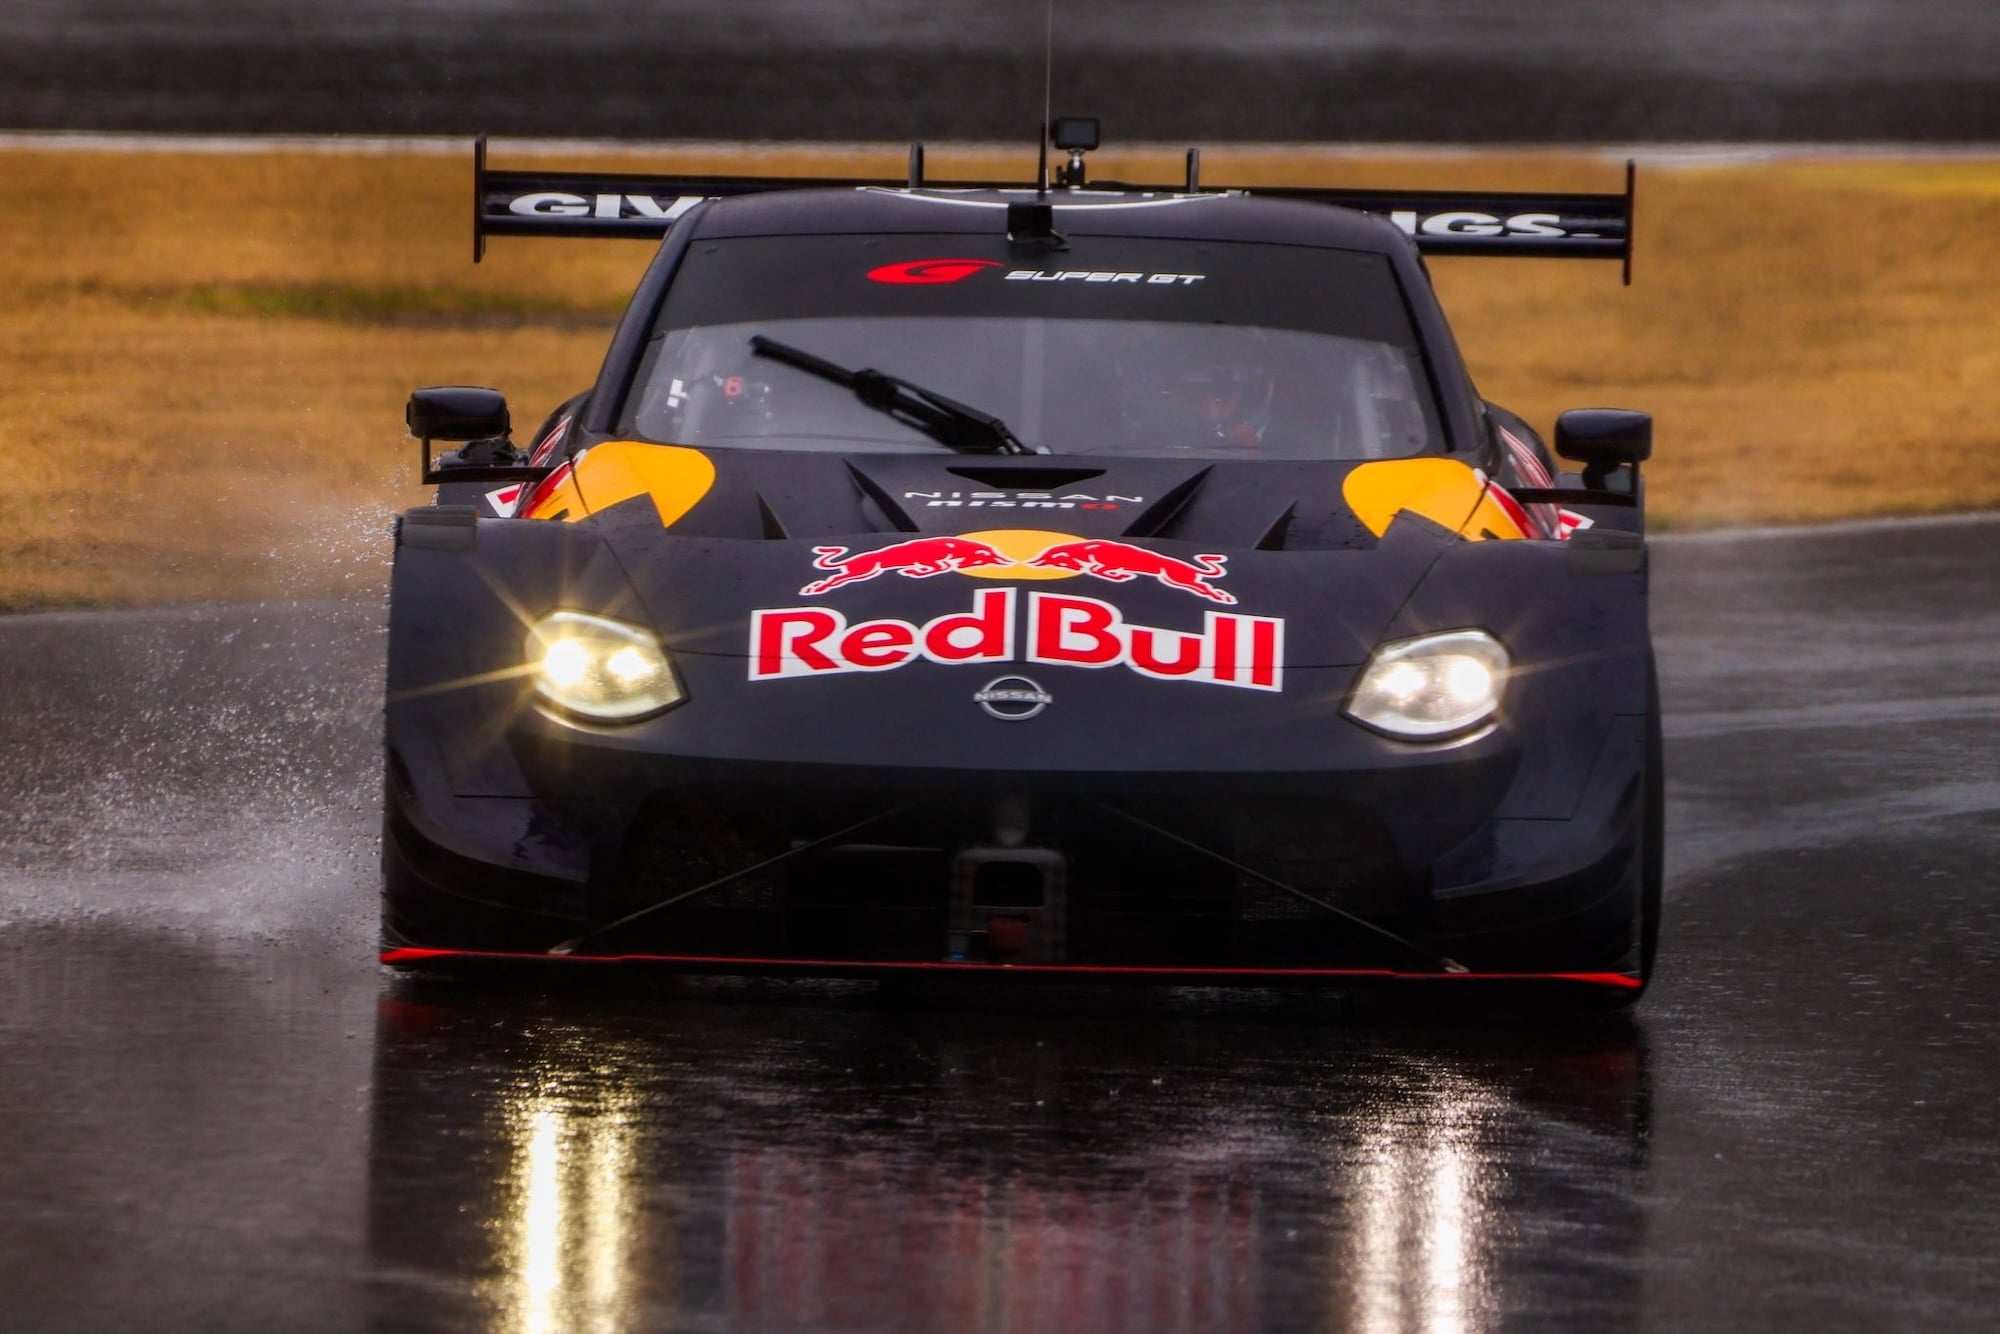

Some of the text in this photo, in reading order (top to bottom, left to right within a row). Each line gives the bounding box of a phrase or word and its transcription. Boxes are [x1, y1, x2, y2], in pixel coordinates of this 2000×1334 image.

[509, 192, 714, 218] GIV
[1004, 269, 1145, 284] SUPER
[1147, 273, 1206, 285] GT
[904, 492, 1143, 503] NISSAN
[755, 590, 1277, 687] Red Bull
[974, 690, 1053, 703] NISSAN
